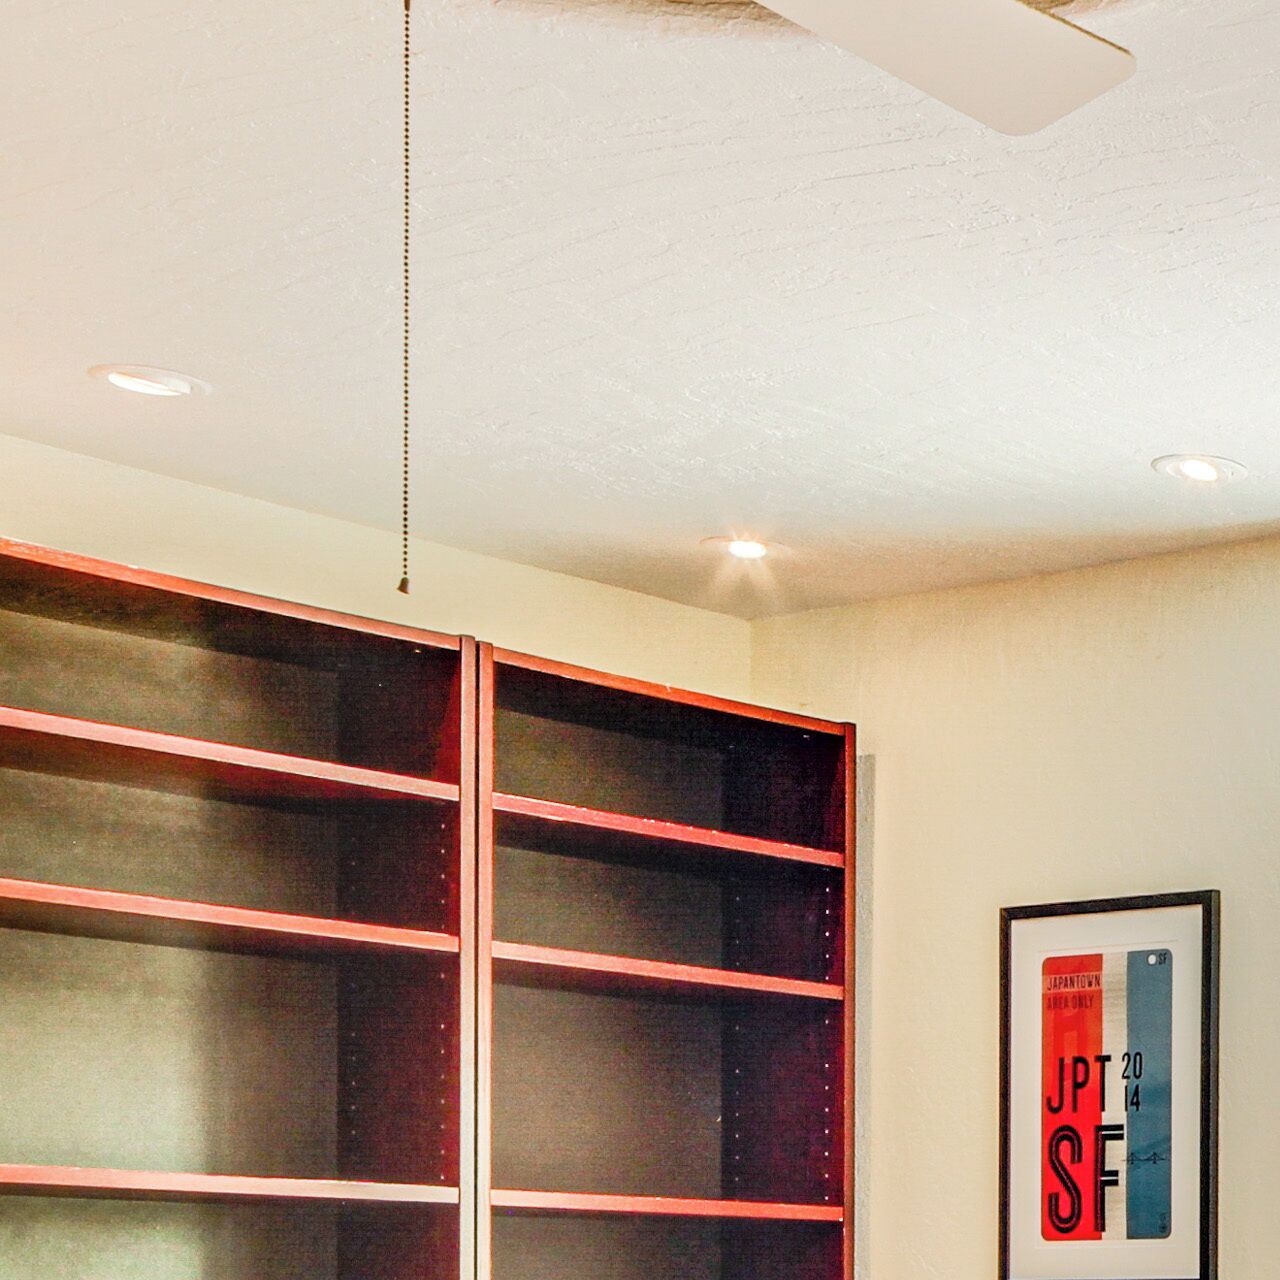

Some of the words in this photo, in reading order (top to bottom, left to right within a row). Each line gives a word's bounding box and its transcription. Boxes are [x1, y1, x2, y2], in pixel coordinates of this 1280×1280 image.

[1158, 952, 1168, 965] SF
[1047, 973, 1101, 991] JAPANTOWN
[1047, 996, 1071, 1010] AREA
[1072, 994, 1095, 1009] ONLY
[1121, 1052, 1143, 1079] 20
[1047, 1055, 1112, 1114] JPT
[1124, 1084, 1141, 1112] 14
[1048, 1124, 1125, 1234] SF
